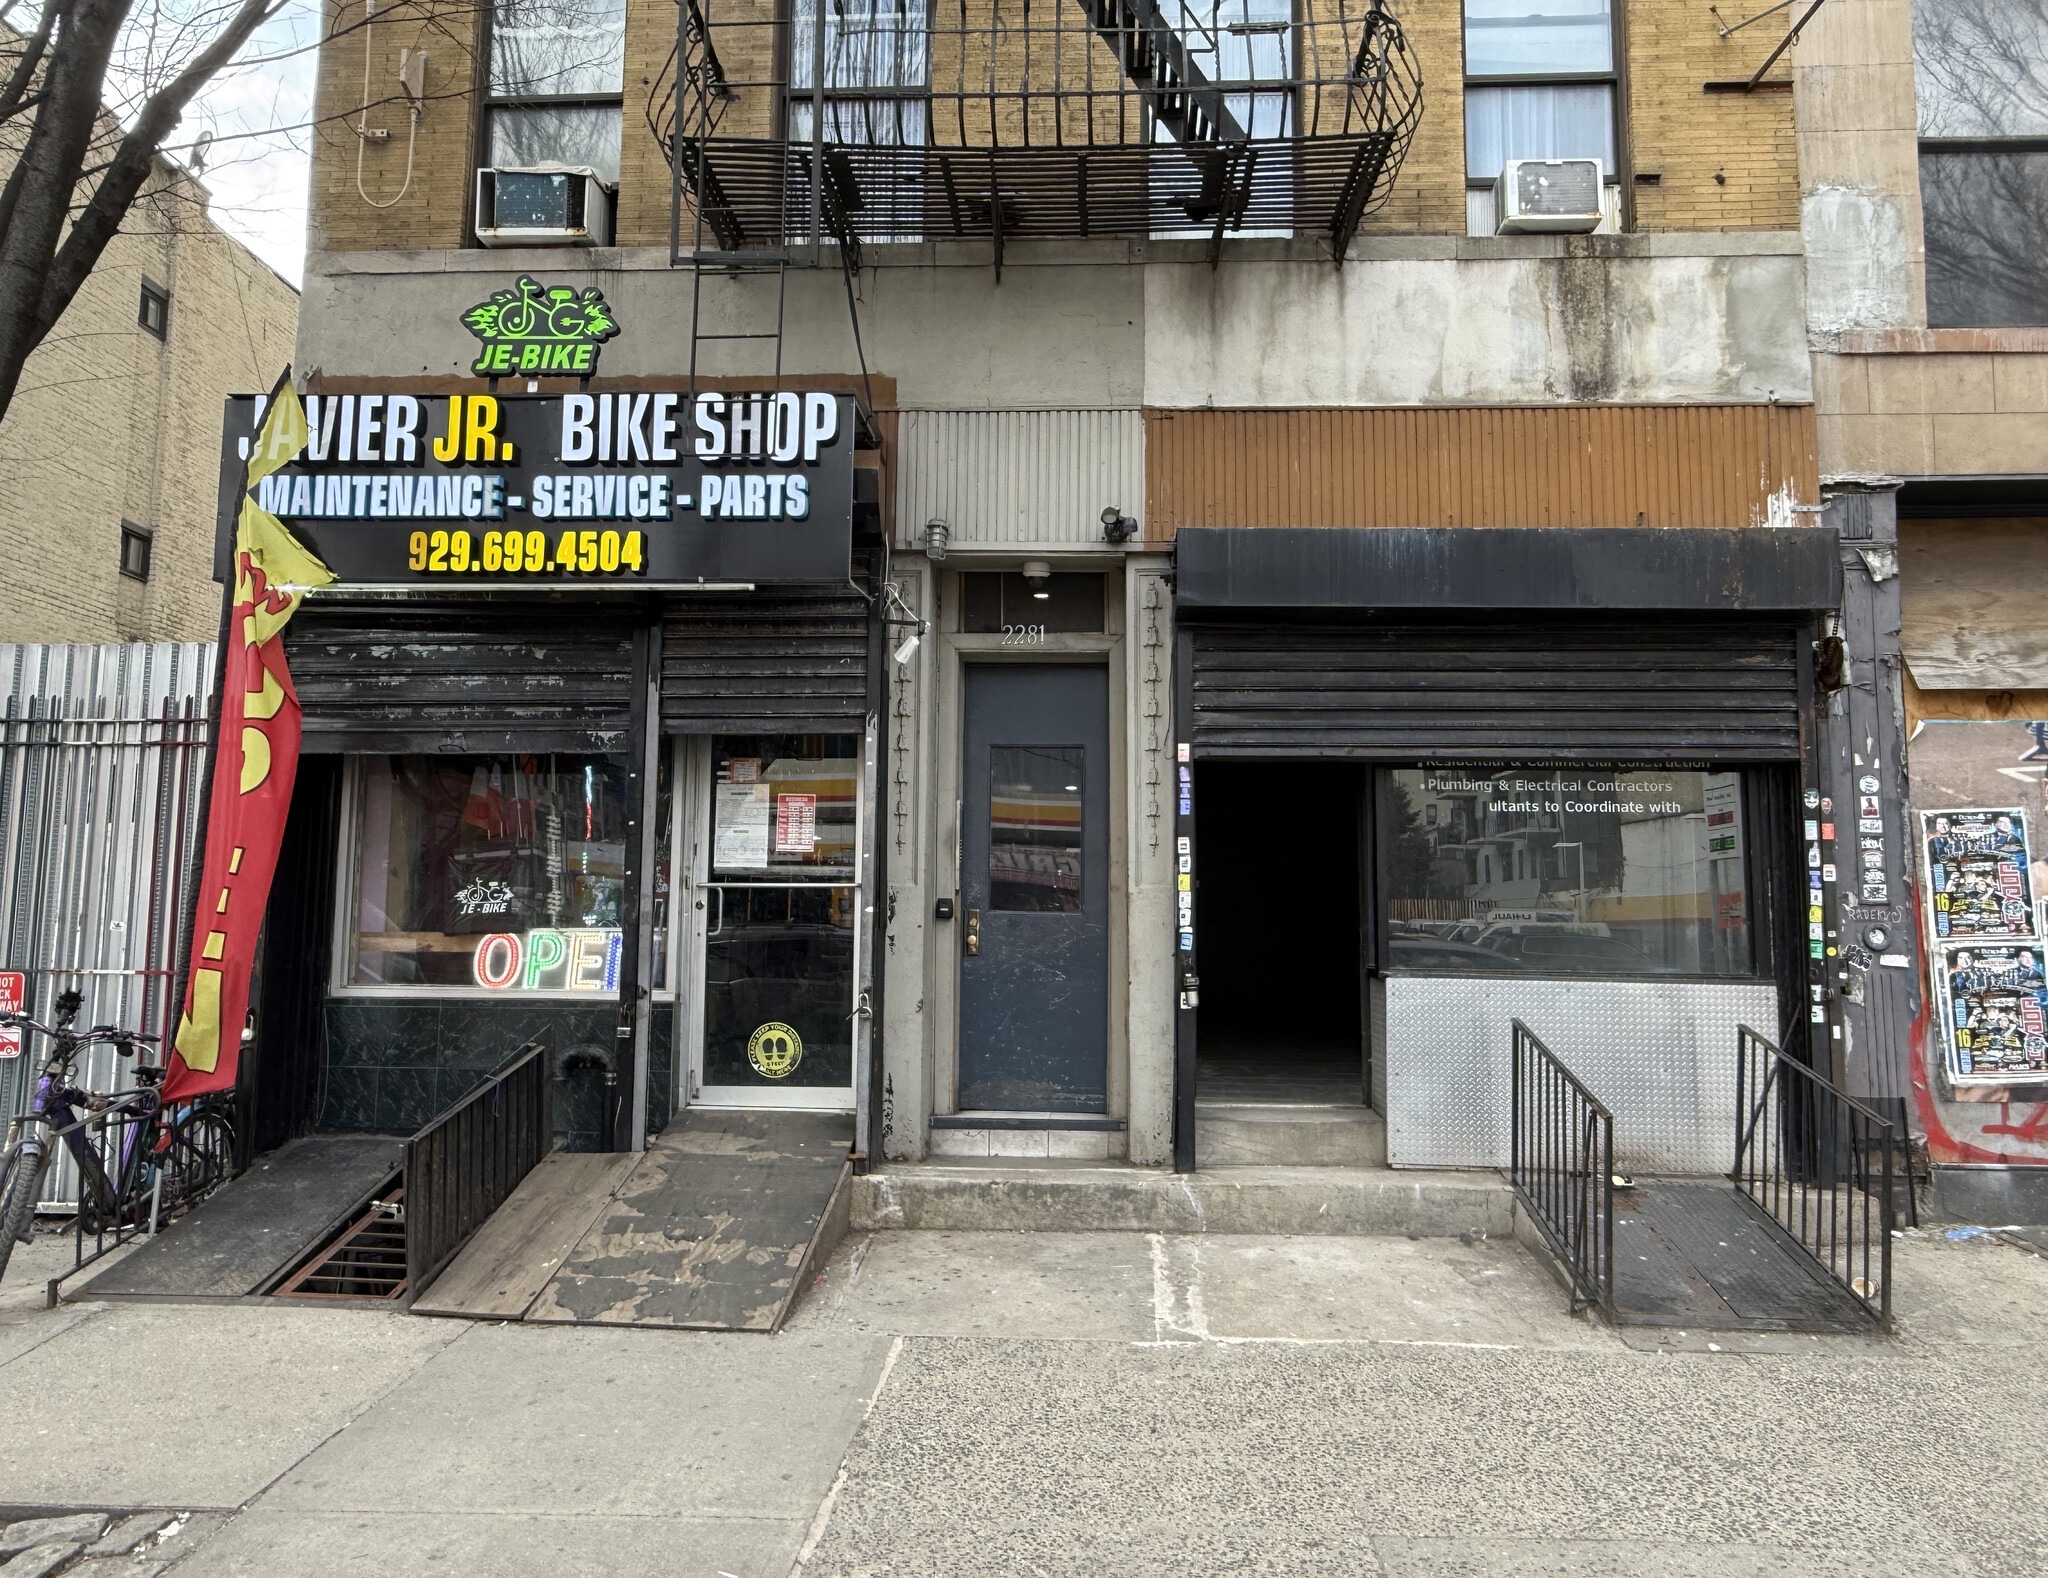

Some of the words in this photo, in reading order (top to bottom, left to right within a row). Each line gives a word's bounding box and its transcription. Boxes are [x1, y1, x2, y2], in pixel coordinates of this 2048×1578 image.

[475, 344, 593, 370] JE-BIKE
[433, 394, 513, 462] JR.
[561, 393, 678, 461] BIKE
[694, 391, 838, 462] SHOP
[259, 474, 502, 517] MAINTENANCE
[532, 474, 668, 517] SERVICE
[700, 474, 808, 518] PARTS
[408, 530, 643, 572] 929.699.4504
[1001, 624, 1044, 645] 2281
[1428, 779, 1493, 793] Plumbing
[1499, 779, 1510, 791] &
[1515, 780, 1581, 791] Electrical
[1587, 780, 1673, 792] Contractors
[1489, 800, 1540, 812] ultants
[1545, 801, 1560, 812] to
[1565, 801, 1644, 813] Coordinate
[1649, 801, 1681, 813] with
[1935, 893, 1949, 911] 16
[0, 977, 14, 988] OT
[1956, 1028, 1971, 1048] 16
